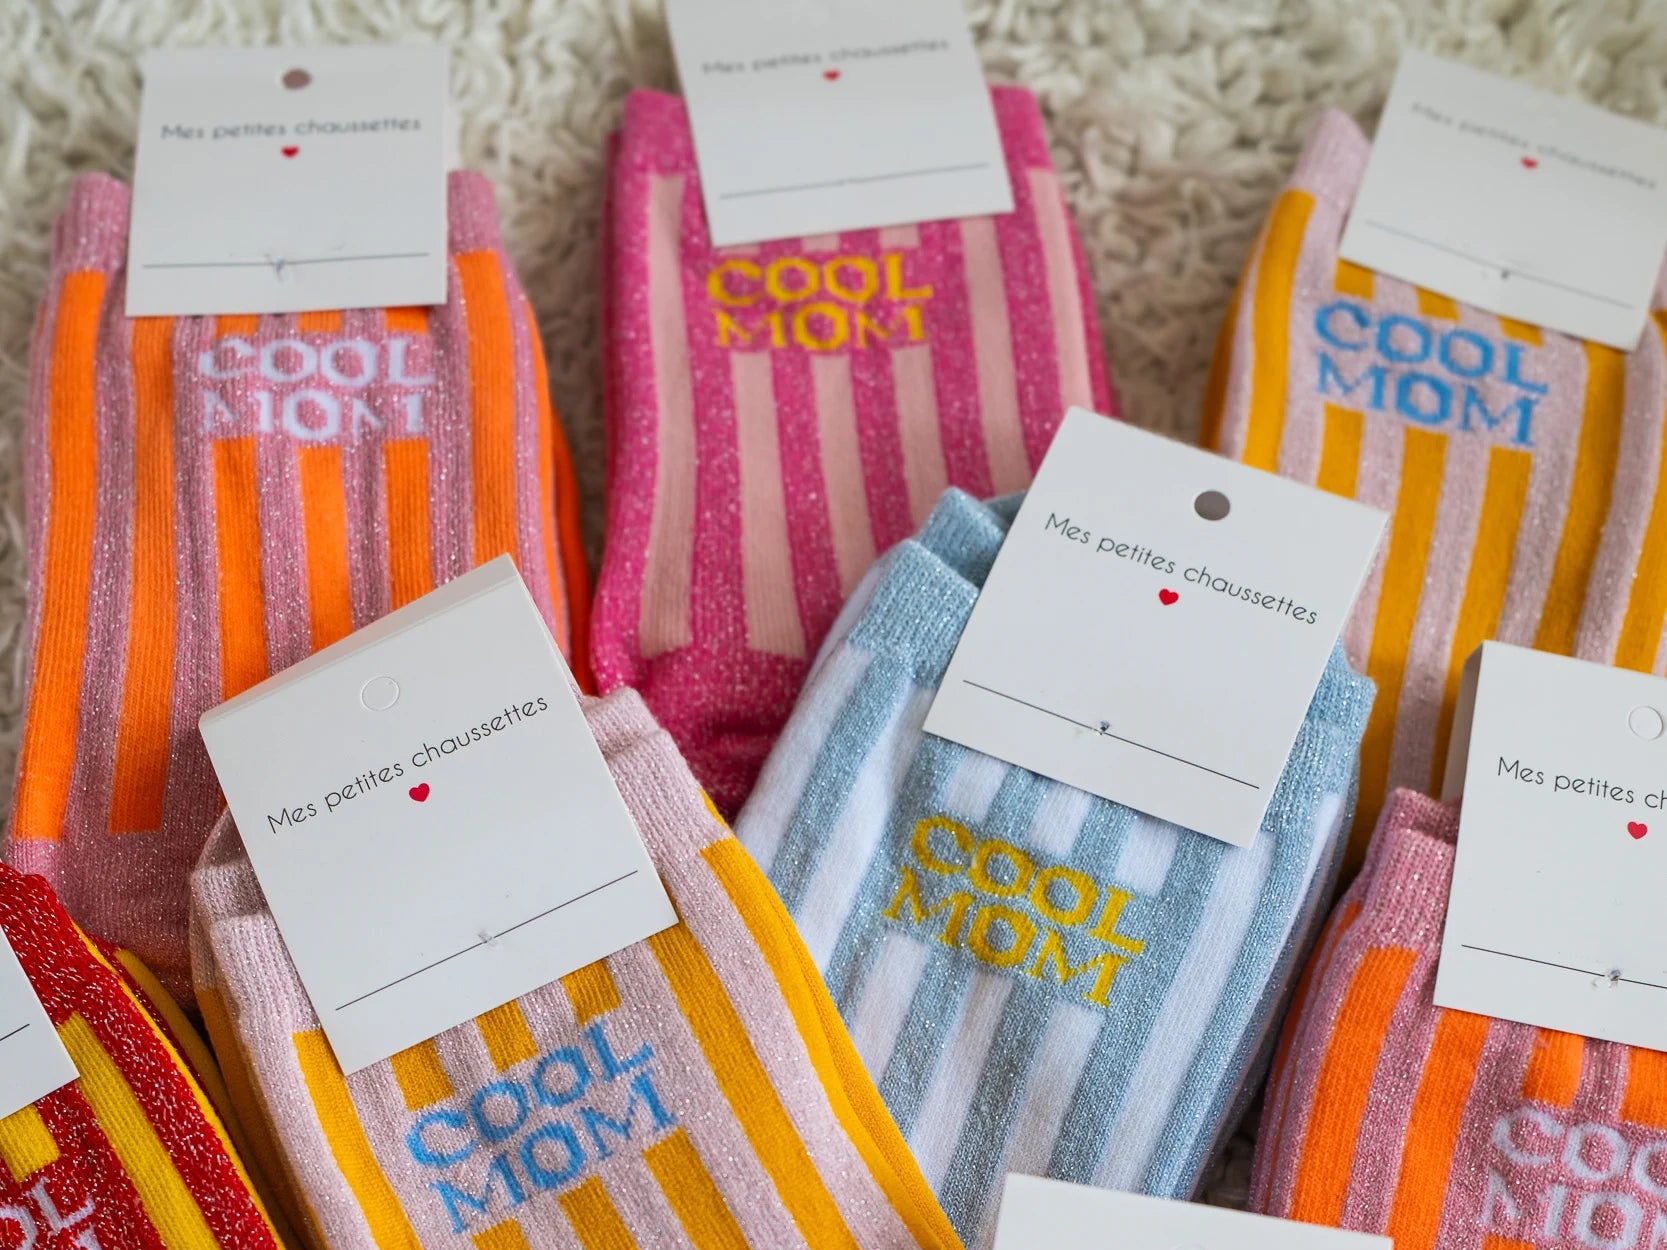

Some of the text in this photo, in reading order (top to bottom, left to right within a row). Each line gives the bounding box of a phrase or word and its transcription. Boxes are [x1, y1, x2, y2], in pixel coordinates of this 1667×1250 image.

[706, 252, 934, 307] COOL
[712, 301, 928, 352] MOM
[199, 336, 436, 388] COOL
[1314, 299, 1549, 395] COOL
[200, 388, 425, 441] MOM
[1315, 350, 1541, 446] MOM
[1044, 512, 1318, 625] Mes petites chaussettes
[266, 697, 549, 835] Mes petites chaussettes
[1497, 756, 1545, 785] Mes
[1553, 775, 1635, 804] petites
[909, 815, 1145, 955] COOL
[882, 866, 1131, 1009] MOM
[404, 1017, 656, 1169] COOL
[428, 1066, 678, 1236] MOM
